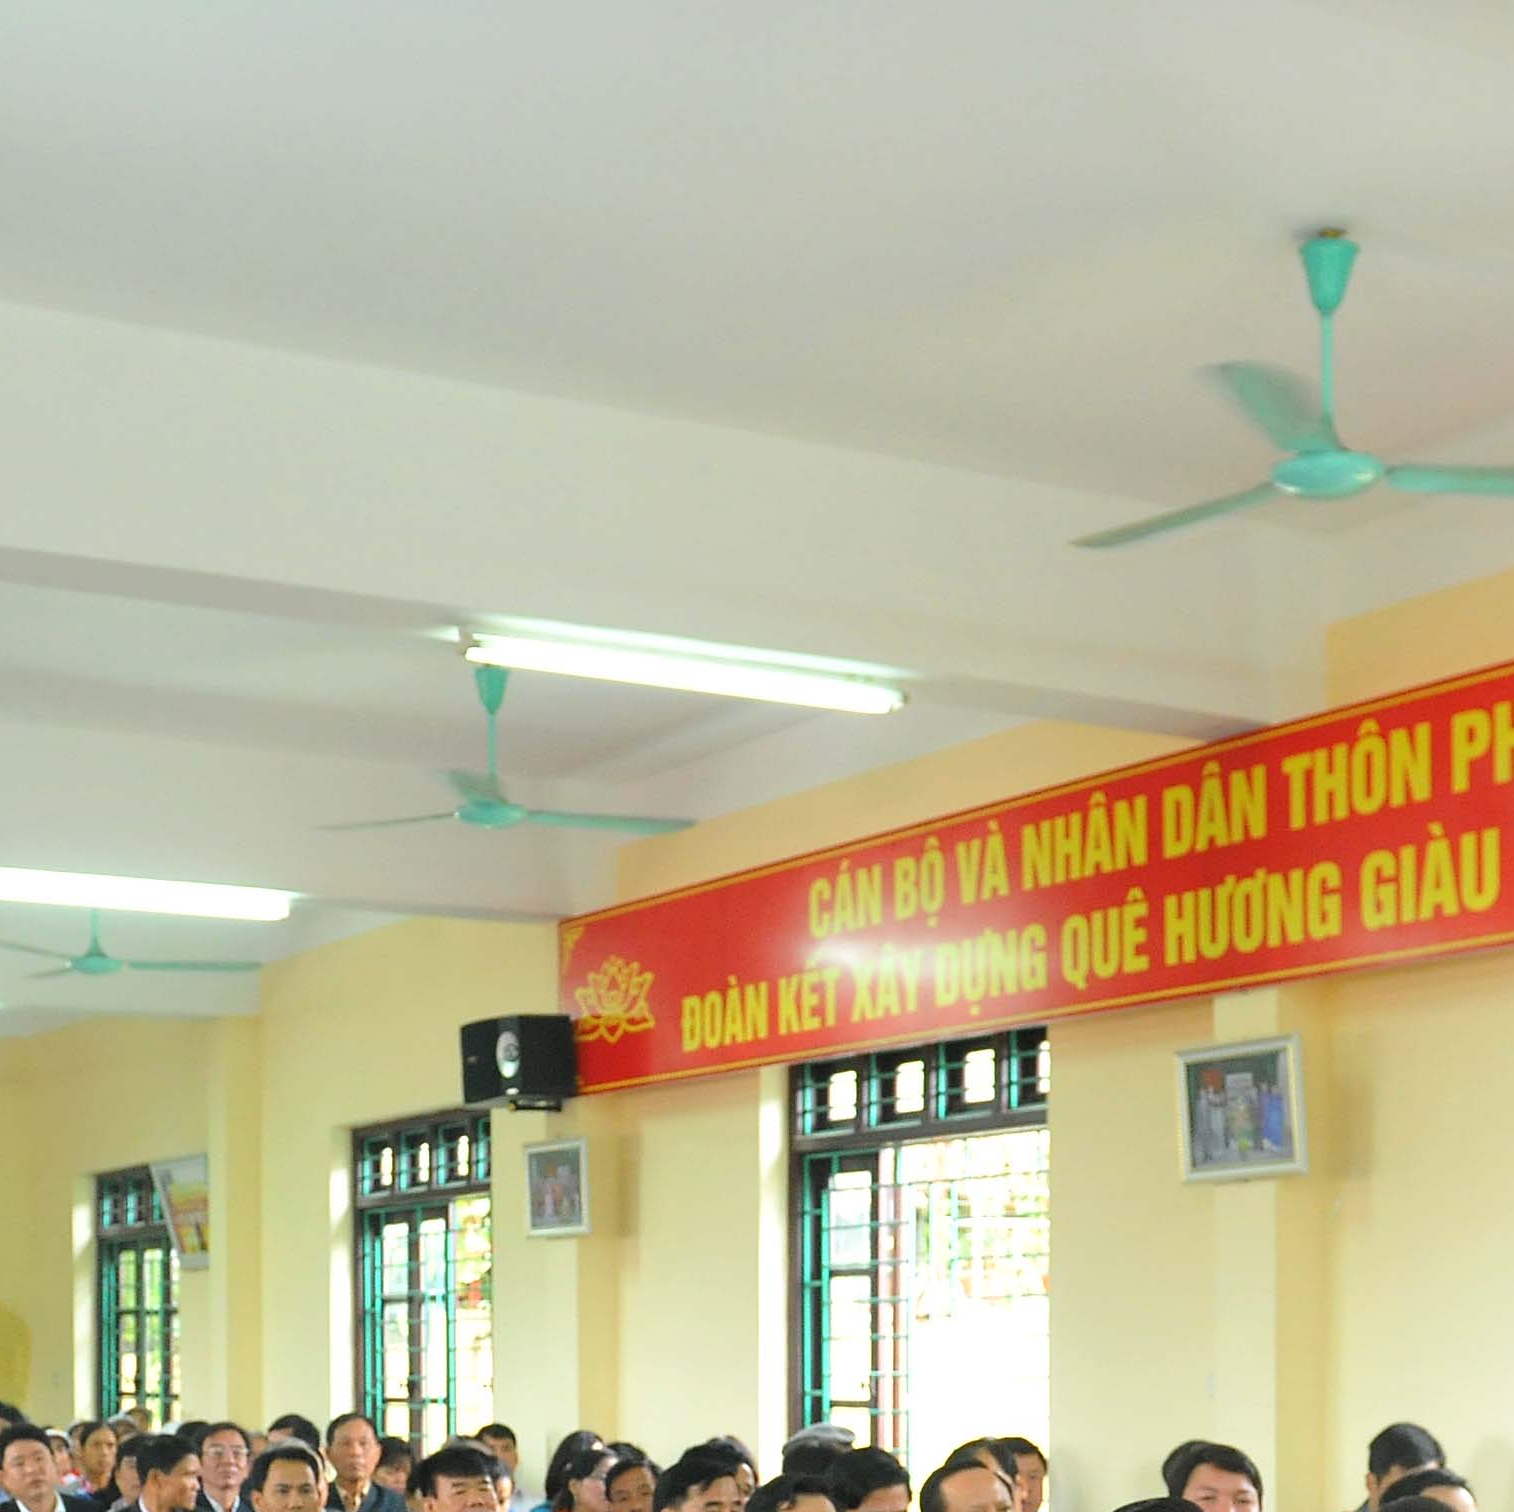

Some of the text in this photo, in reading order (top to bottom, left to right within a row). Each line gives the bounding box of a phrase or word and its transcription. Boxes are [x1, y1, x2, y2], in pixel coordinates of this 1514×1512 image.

[682, 976, 768, 1052] ĐOÀN
[778, 954, 840, 1035] KẾT
[851, 943, 923, 1023] XÂY
[936, 926, 1046, 1014] DỰNG
[1062, 890, 1149, 988] QUÊ
[1165, 862, 1341, 964] HƯƠNG
[1360, 823, 1501, 932] GIÀU
[809, 861, 881, 938] CÁN
[895, 837, 945, 928] BỘ
[957, 822, 1009, 905] VÀ
[1023, 793, 1148, 890] NHÂN
[1163, 760, 1267, 858] DÂN
[1282, 719, 1431, 829] THÔN
